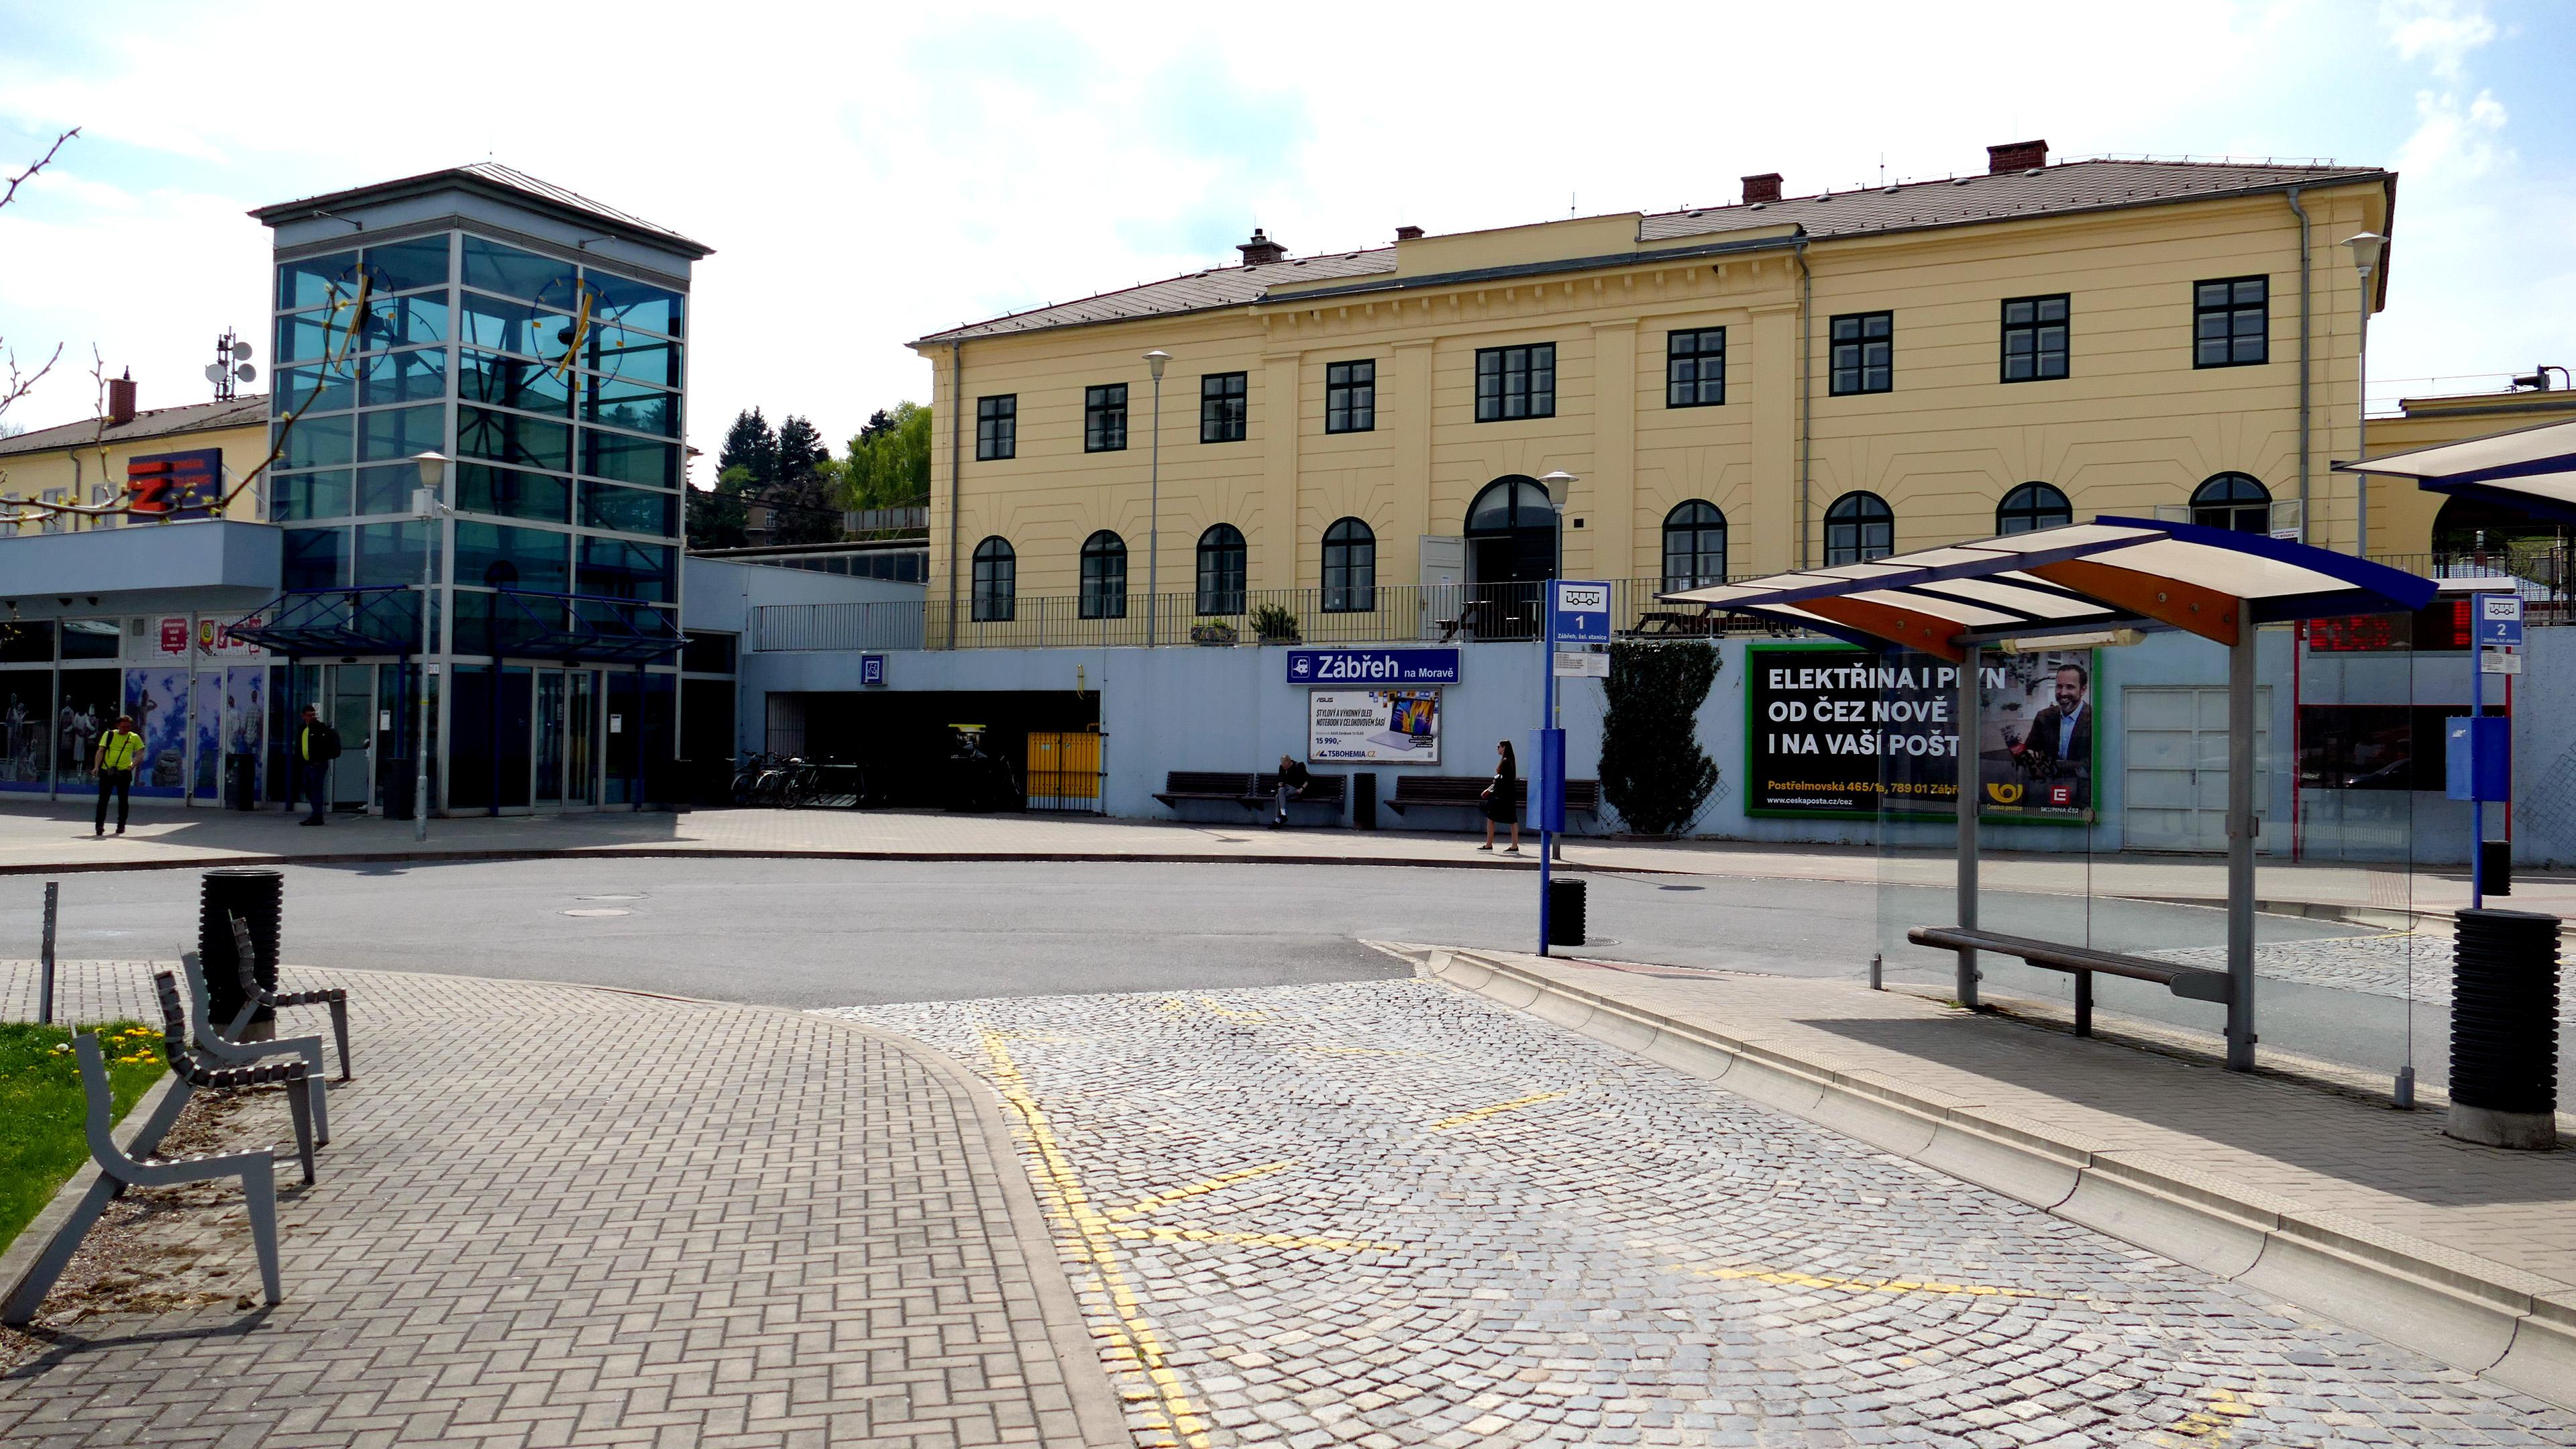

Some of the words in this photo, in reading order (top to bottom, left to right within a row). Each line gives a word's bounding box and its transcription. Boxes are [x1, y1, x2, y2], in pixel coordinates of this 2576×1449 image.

[1575, 615, 1583, 629] 1
[2498, 623, 2506, 635] 2
[1317, 655, 1399, 678] Zábřeh
[1404, 669, 1415, 678] na
[1418, 667, 1454, 678] Moravě
[1769, 662, 1915, 689] ELEKTŘINA
[1923, 667, 1929, 688] I
[1316, 708, 1336, 717] STYLOVÝ
[1361, 709, 1373, 717] OLED
[1768, 701, 1807, 722] OD
[1813, 696, 1865, 722] ČEZ
[1872, 696, 1948, 722] NOVĚ
[1316, 718, 1340, 726] NOTEBOOK
[1324, 737, 1342, 745] 990,-
[1769, 733, 1775, 754] I
[1782, 733, 1819, 754] NA
[1825, 729, 1883, 755] VAŠÍ
[1890, 729, 1960, 757] POŠT
[1768, 781, 1845, 791] Postřelmovská
[1847, 782, 1888, 794] 465/1a,
[1890, 783, 1912, 793] 789
[1914, 784, 1928, 793] 01
[1767, 797, 1853, 805] www.ceskaposta.cz/cez
